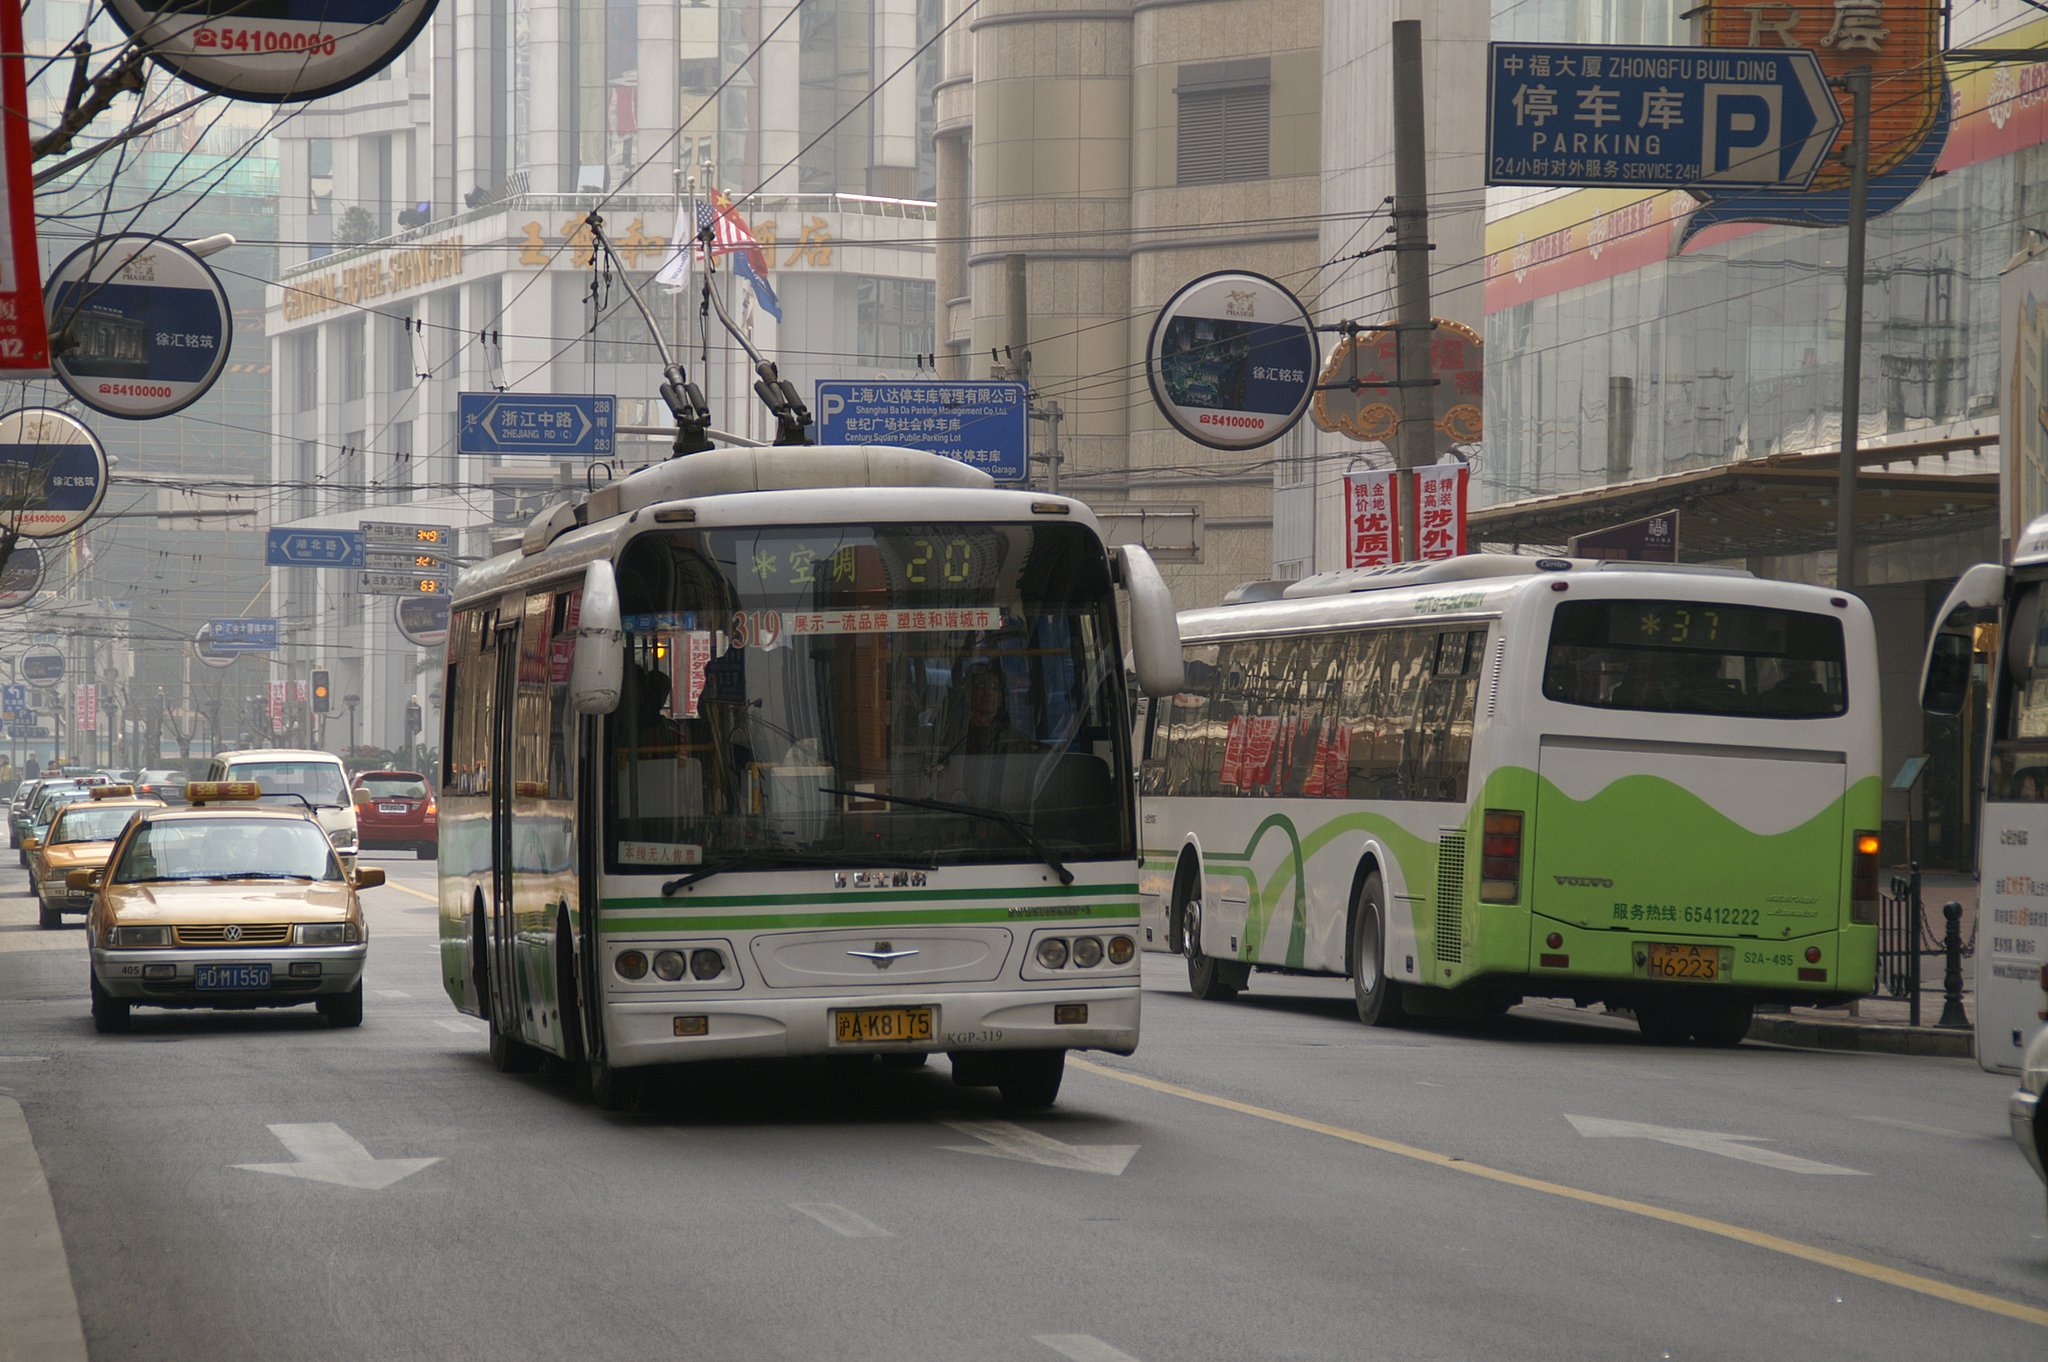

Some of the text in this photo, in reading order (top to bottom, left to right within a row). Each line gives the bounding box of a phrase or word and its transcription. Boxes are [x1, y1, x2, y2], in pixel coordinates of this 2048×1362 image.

[221, 29, 335, 56] 54100000
[1503, 55, 1777, 81] 中福大厦 ZHONGFU BUILDING
[1512, 83, 1685, 129] 停车库
[1532, 132, 1661, 155] PARKING
[1495, 157, 1701, 180] 24小时对外服务 SERVICE 24H
[155, 332, 214, 349] 徐汇铭筑
[1252, 366, 1304, 383] 徐汇铭筑
[113, 386, 171, 398] 54100000
[847, 387, 1017, 404] 上海八达停车库管理有限公司
[501, 411, 573, 428] 浙江中路
[856, 406, 888, 416] Shanghai
[889, 406, 899, 414] Ba
[900, 406, 910, 414] Da
[911, 406, 938, 416] Parking
[846, 418, 961, 431] 世纪广场社会停车库
[1211, 414, 1264, 429] 54100000
[502, 429, 539, 439] ZHEJIANG
[544, 429, 556, 439] RD
[845, 433, 962, 443] Century Square Public Parking Lot
[52, 476, 95, 487] 徐汇铭筑
[1355, 484, 1369, 512] 银价
[1372, 483, 1385, 510] 金地
[1424, 480, 1437, 508] 超高
[1440, 478, 1453, 506] 精装
[20, 514, 66, 523] 54100000
[789, 540, 971, 584] 空调 20
[732, 610, 782, 649] 319
[793, 611, 989, 631] 展示一流品牌 塑造和谐城市
[1671, 610, 1719, 642] 37
[1553, 876, 1614, 888] VOLVO
[1651, 957, 1715, 979] H6223
[1744, 952, 1794, 967] S2A-495
[122, 966, 140, 975] 405
[947, 1030, 1003, 1044] KGP-319
